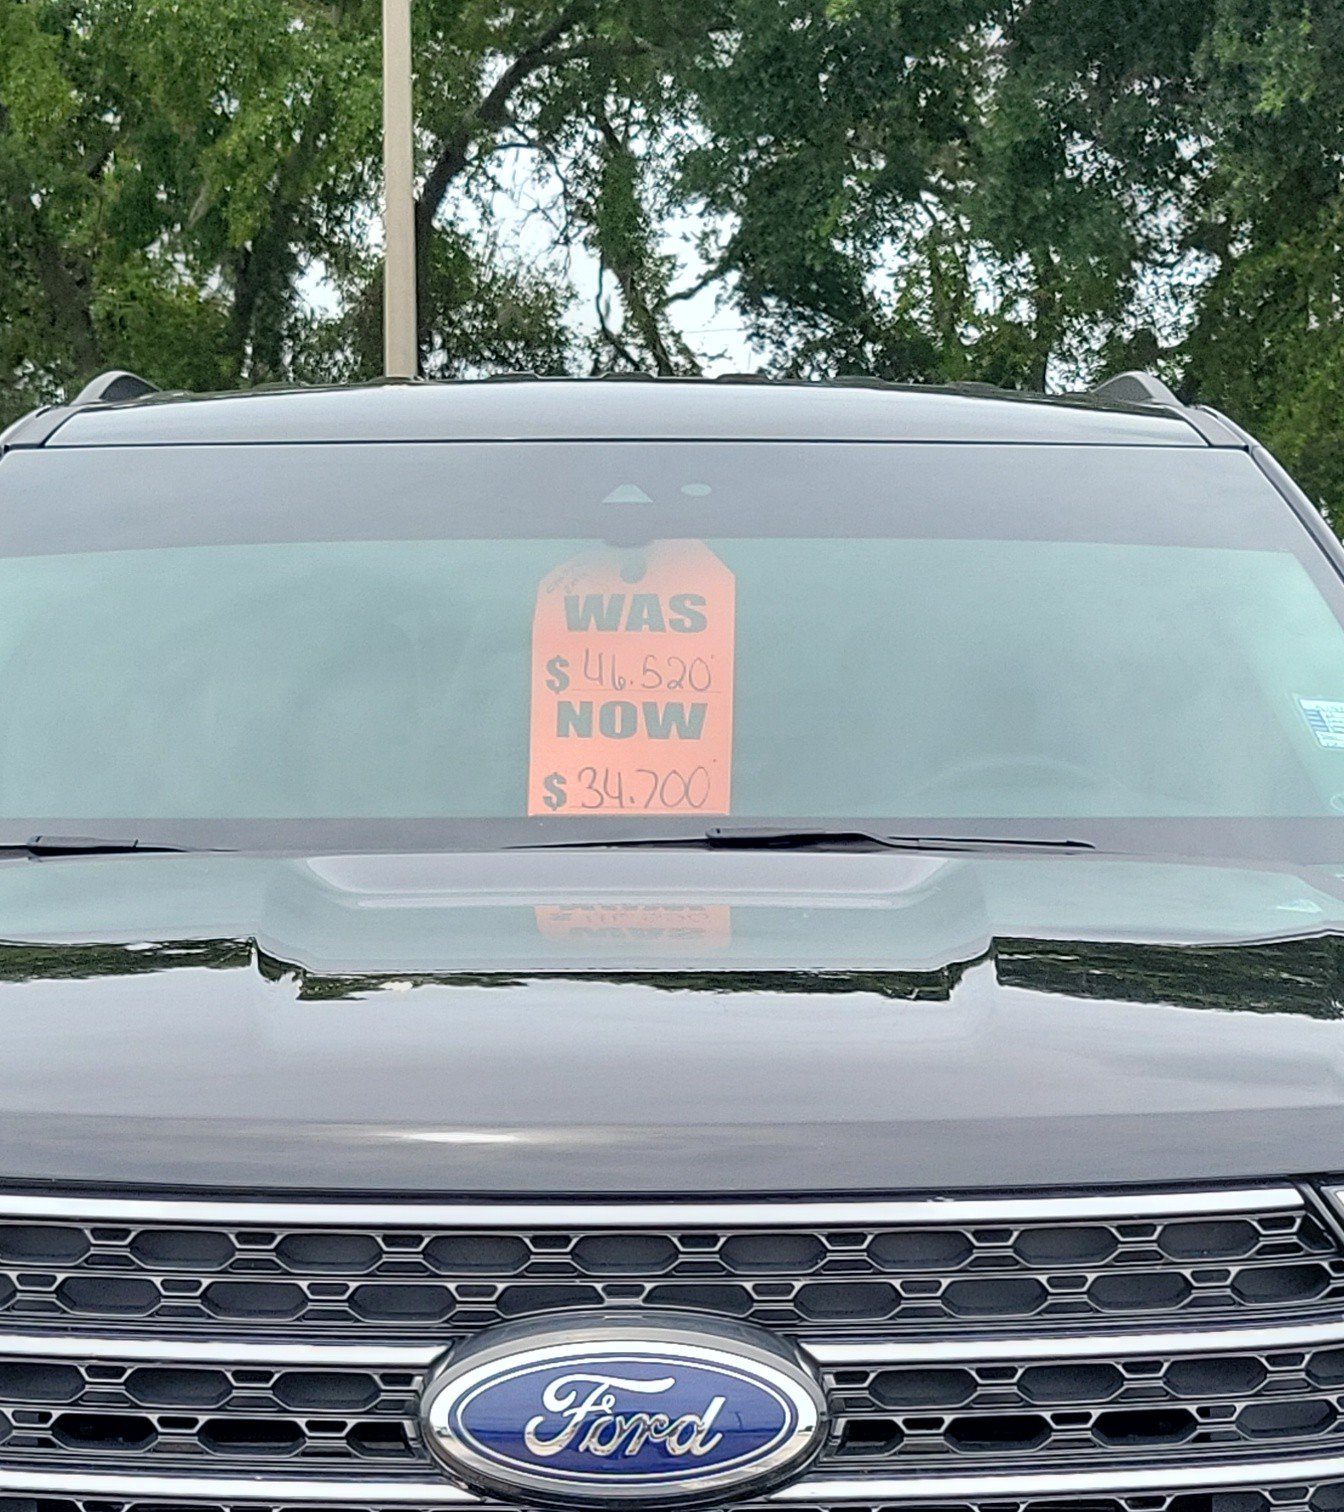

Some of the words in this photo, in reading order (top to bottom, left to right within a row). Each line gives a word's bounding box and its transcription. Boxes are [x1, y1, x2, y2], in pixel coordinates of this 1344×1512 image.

[564, 593, 708, 634] WAS
[556, 700, 709, 740] NOW
[523, 1372, 727, 1458] Ford
